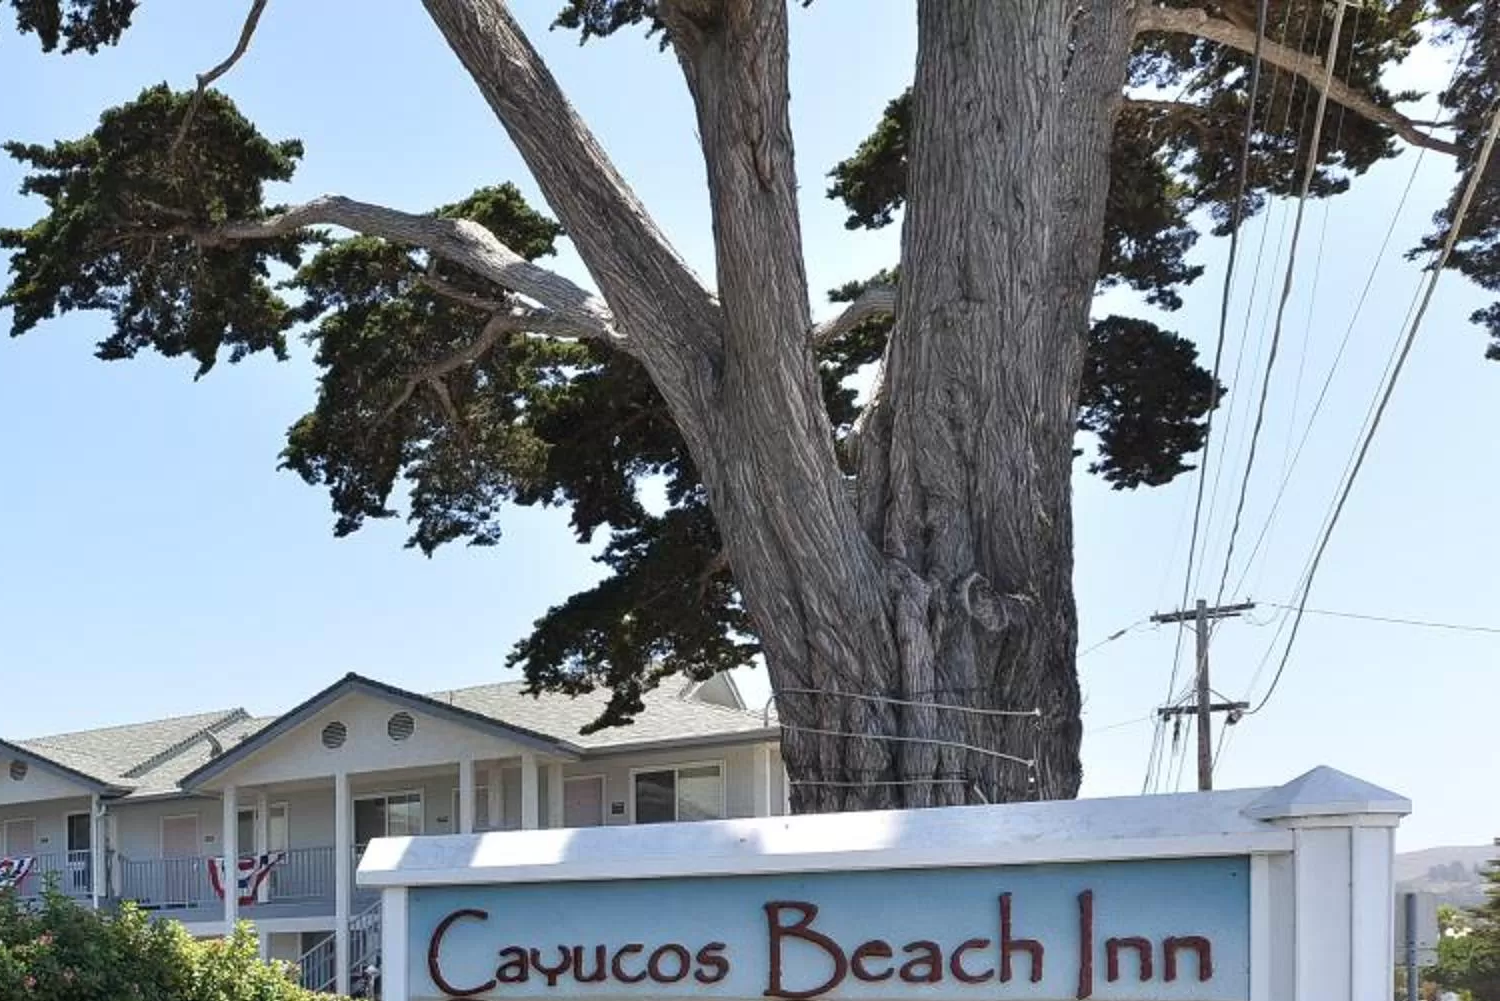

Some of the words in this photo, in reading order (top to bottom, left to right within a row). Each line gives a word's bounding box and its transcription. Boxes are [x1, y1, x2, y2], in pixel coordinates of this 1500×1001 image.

[428, 908, 731, 997] Cayucos
[763, 891, 1045, 999] Beach
[1077, 889, 1214, 1000] Inn
